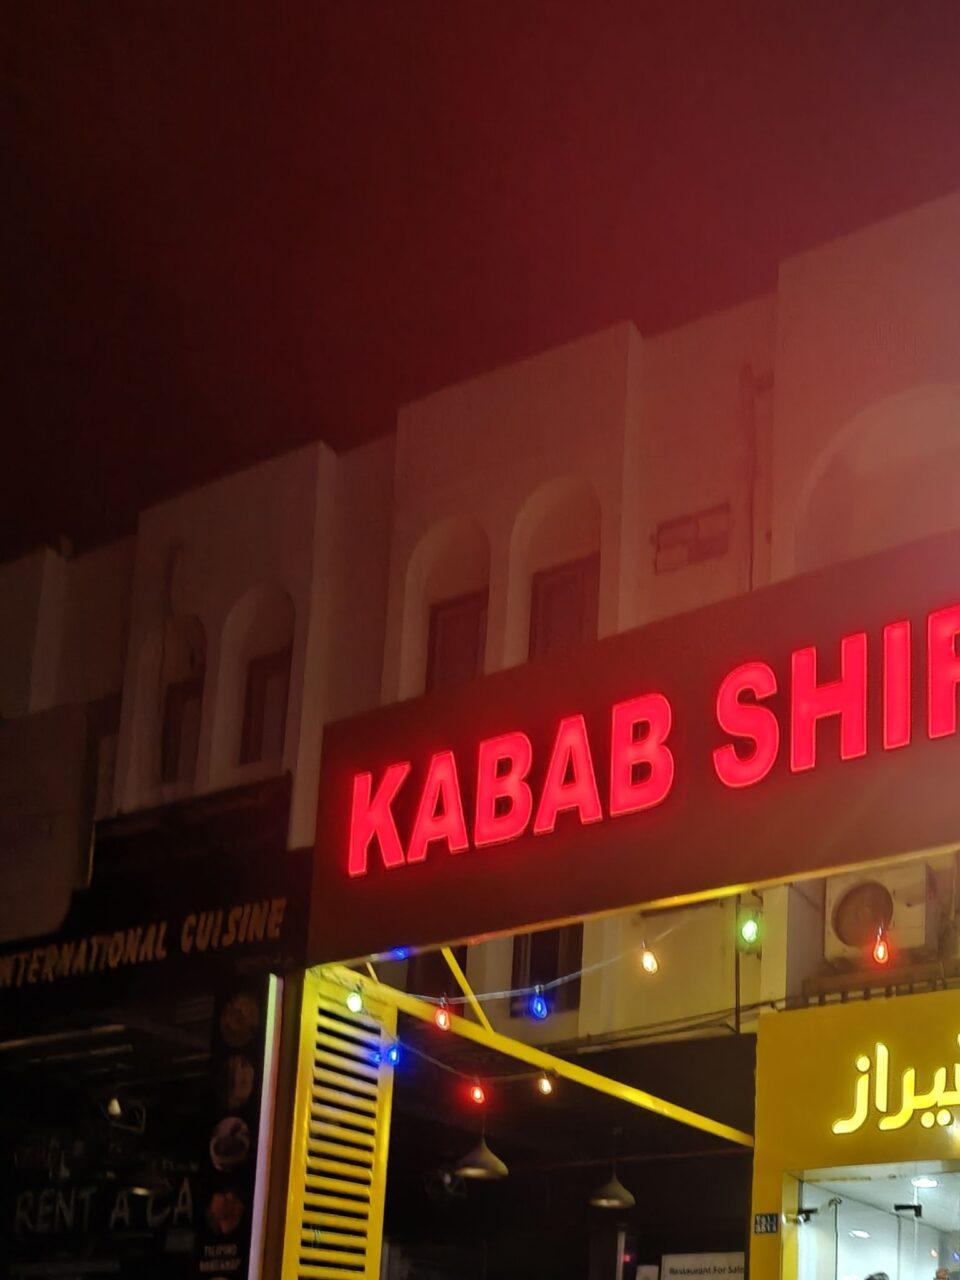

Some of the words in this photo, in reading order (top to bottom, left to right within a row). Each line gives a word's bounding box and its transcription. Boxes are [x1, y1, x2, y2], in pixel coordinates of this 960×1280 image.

[348, 692, 676, 878] KABAB
[0, 920, 168, 988] NTERNATIONAL
[180, 897, 287, 954] CUISINE
[16, 1187, 95, 1235] RENT
[669, 1266, 711, 1276] Restaurant
[714, 1265, 726, 1274] For
[728, 1264, 745, 1274] Sale
